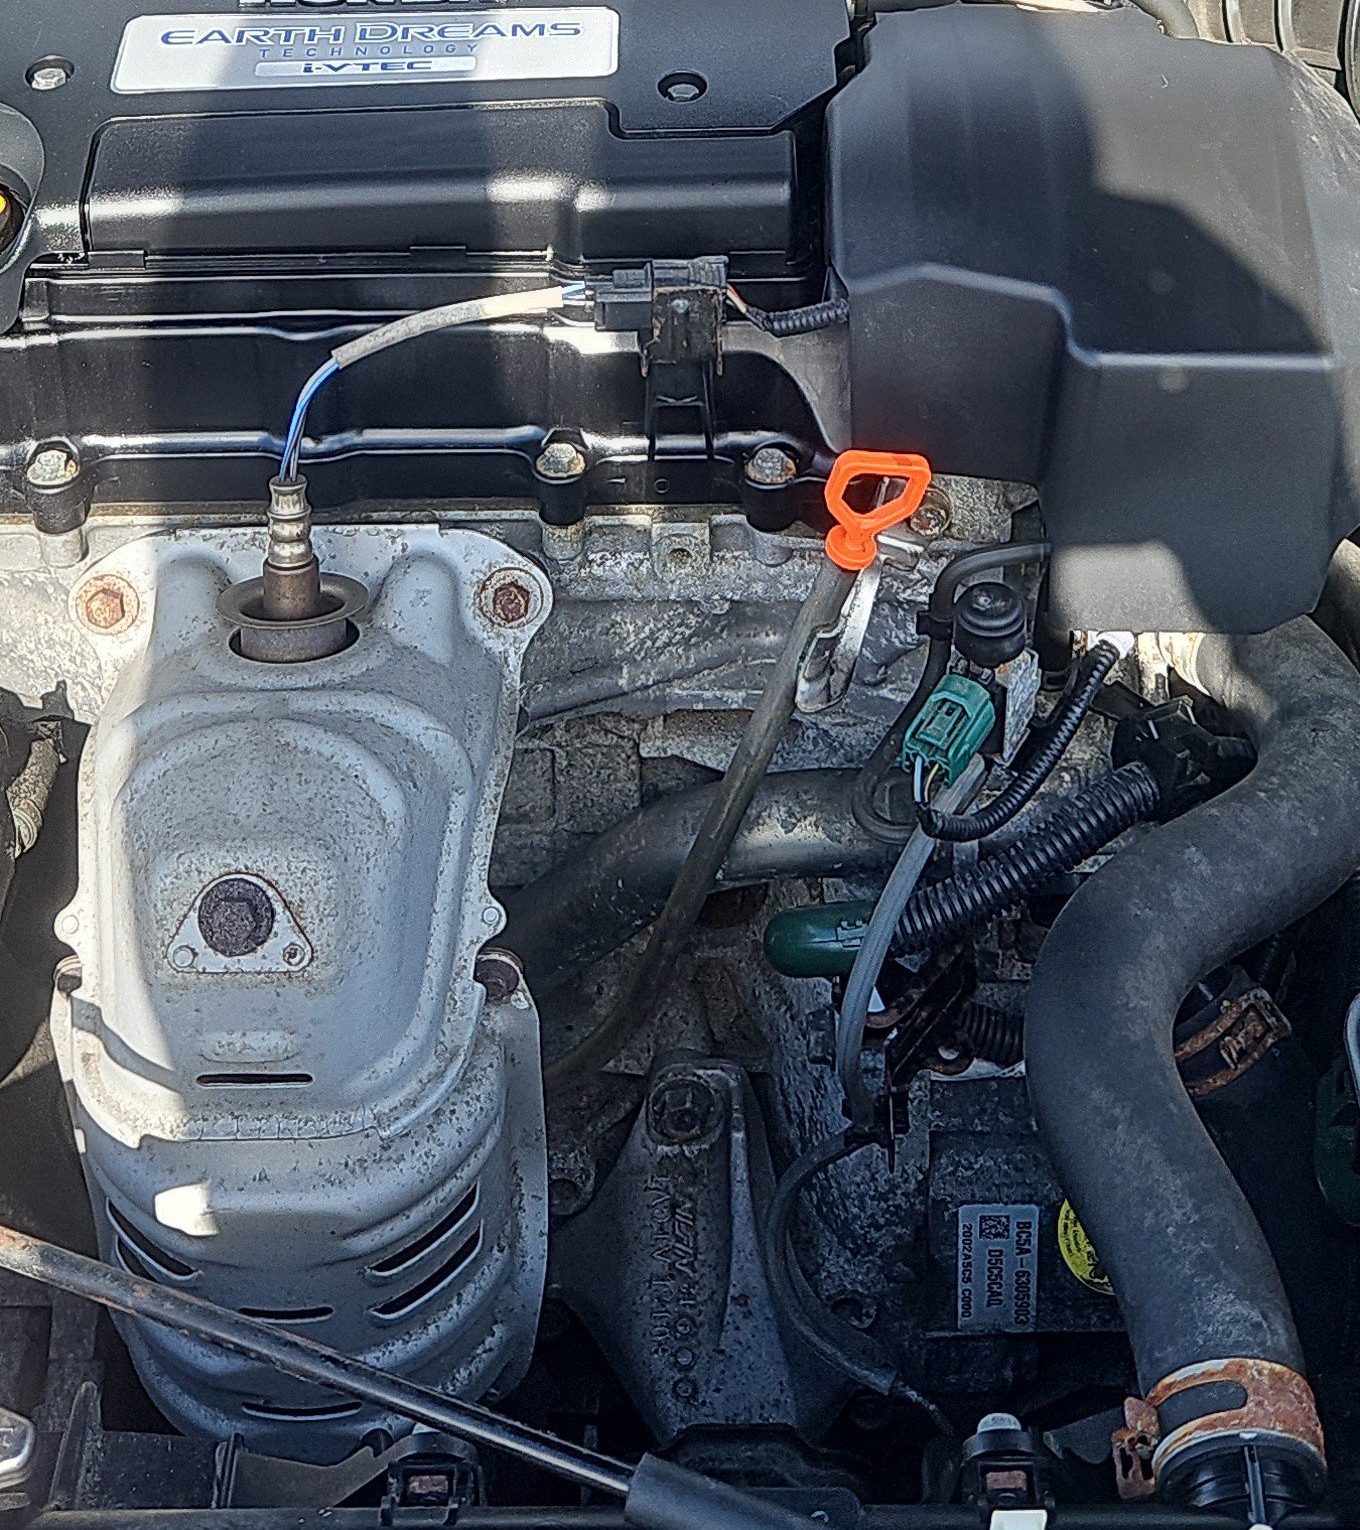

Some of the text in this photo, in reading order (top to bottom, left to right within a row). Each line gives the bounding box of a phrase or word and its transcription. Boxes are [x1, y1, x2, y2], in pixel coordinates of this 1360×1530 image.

[160, 20, 582, 48] EARTH DREAMS
[259, 43, 480, 59] TECHNOLOGY
[302, 60, 435, 73] i-VTEC
